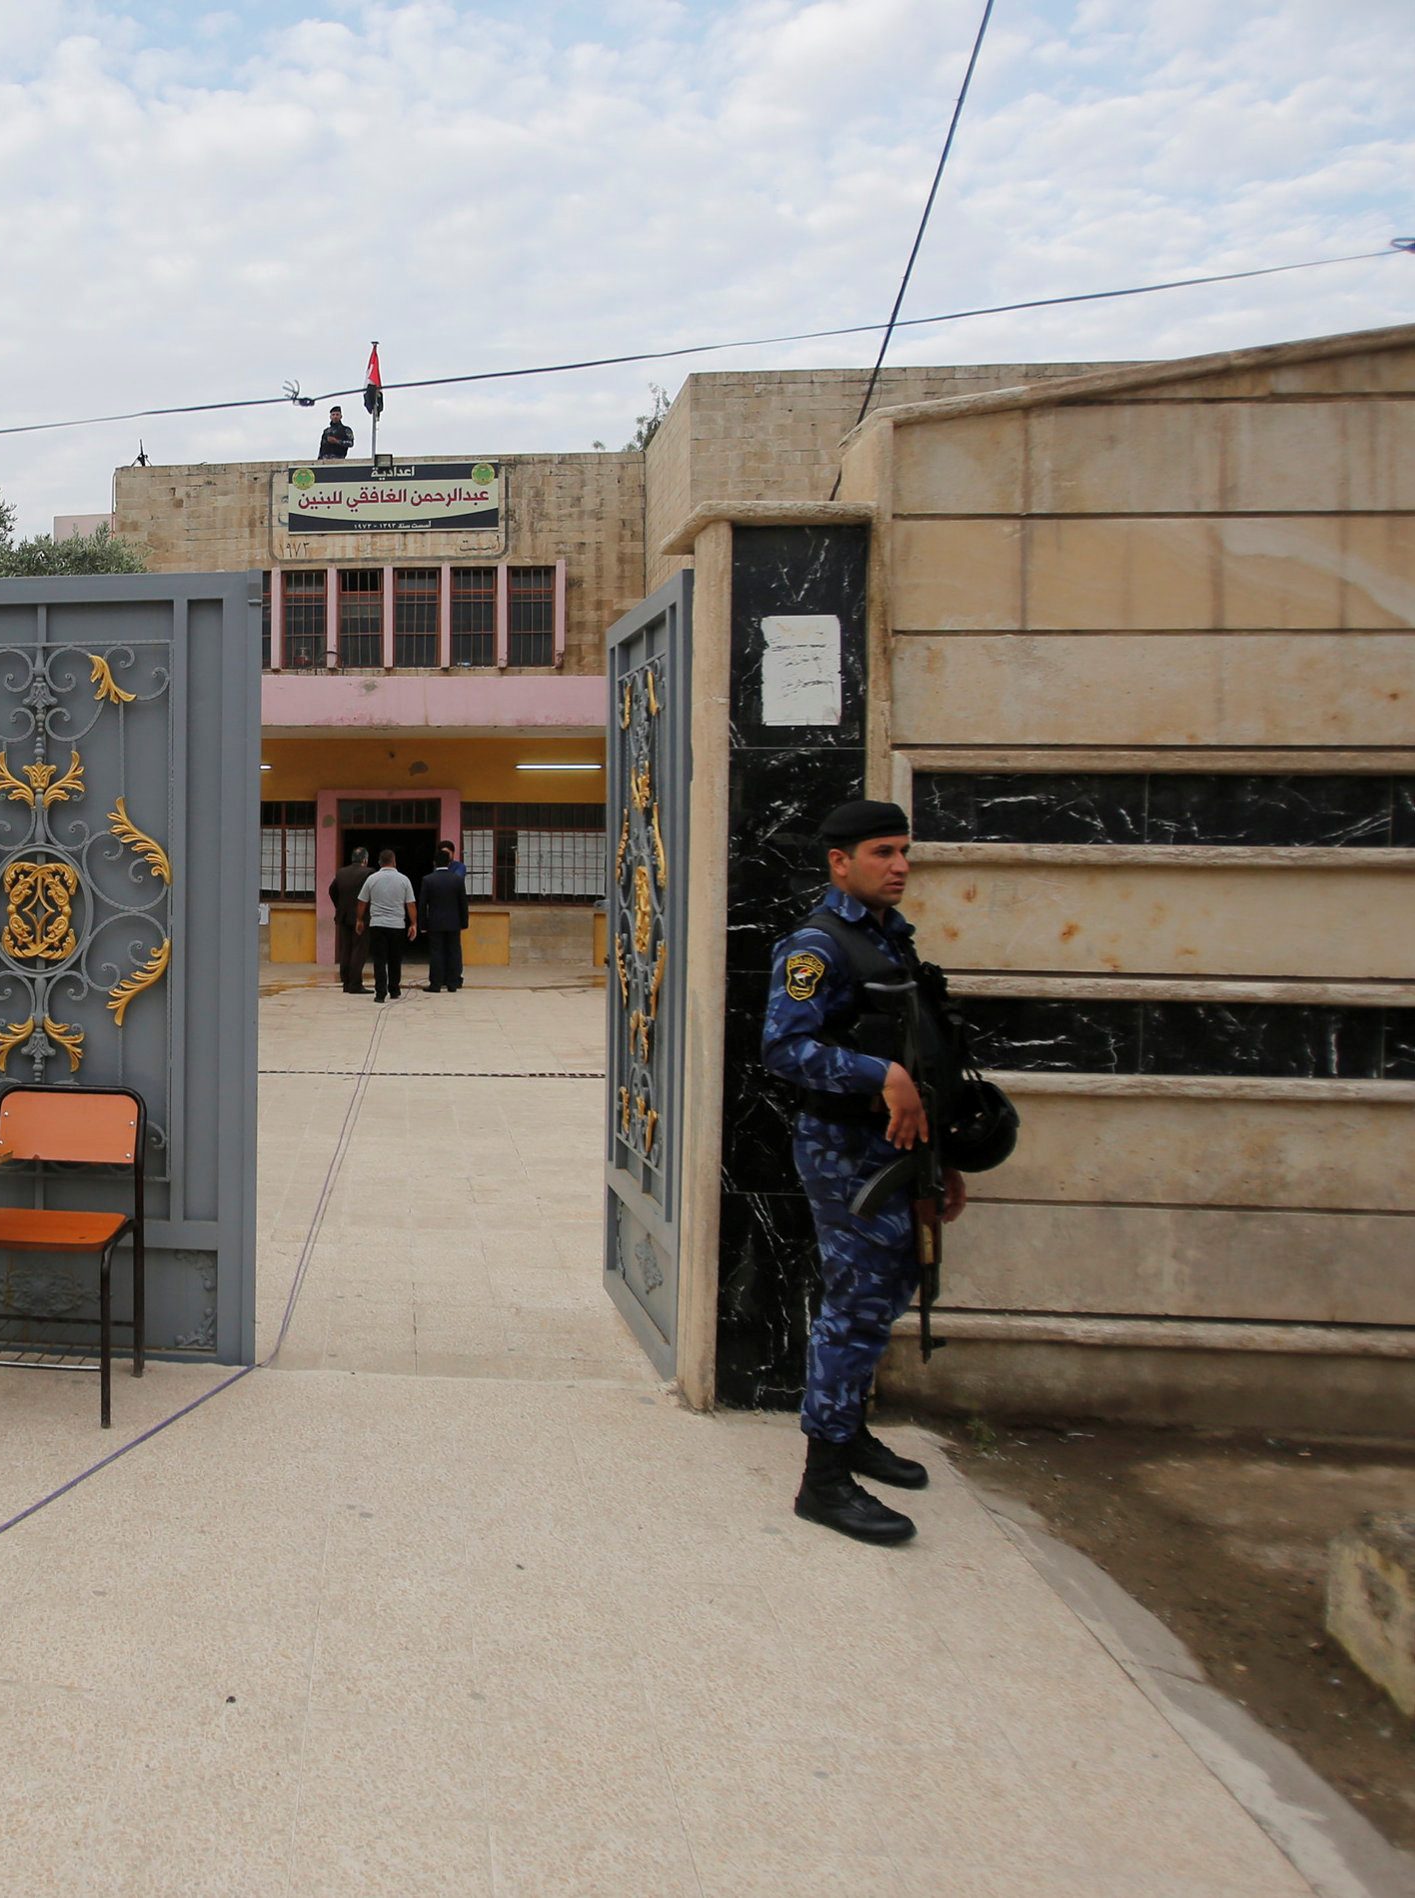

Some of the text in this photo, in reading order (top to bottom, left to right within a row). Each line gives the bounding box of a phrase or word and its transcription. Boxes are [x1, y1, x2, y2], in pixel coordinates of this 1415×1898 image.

[298, 491, 342, 509] للبنين
[346, 486, 407, 512] الغافقي
[411, 487, 489, 507] عبدالرحمن
